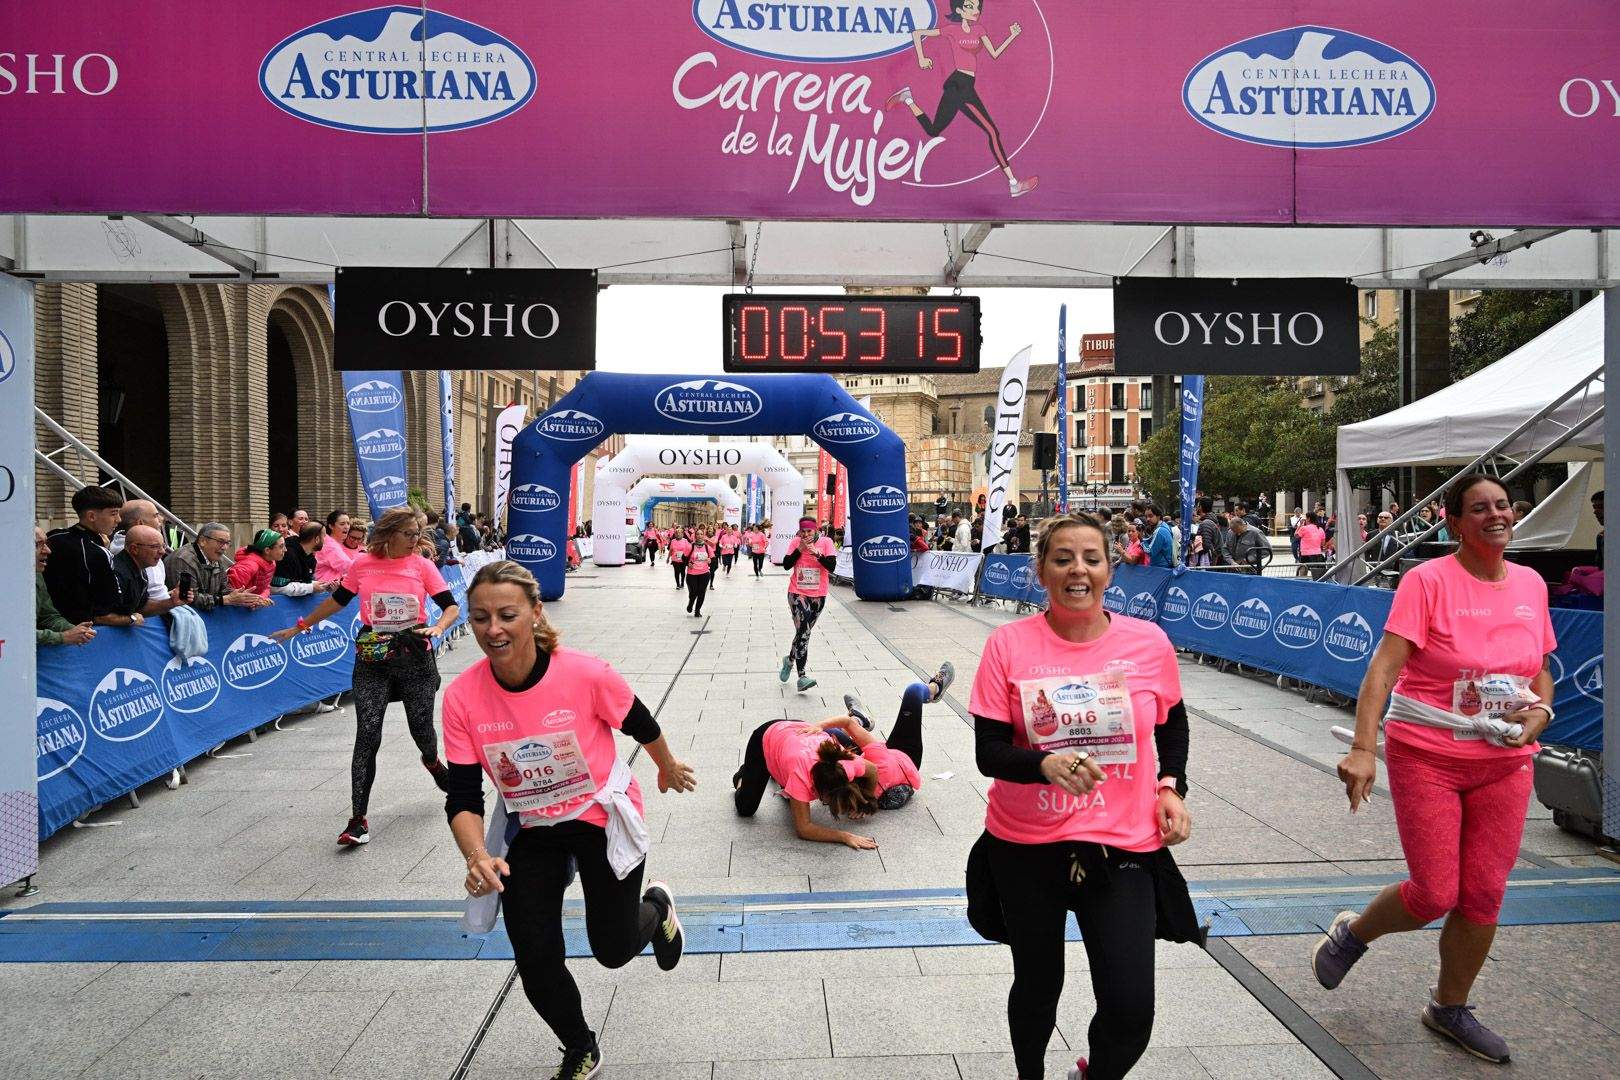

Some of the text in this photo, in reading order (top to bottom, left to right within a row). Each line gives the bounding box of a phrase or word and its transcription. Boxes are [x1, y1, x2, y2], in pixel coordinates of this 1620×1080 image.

[712, 0, 917, 34] ASTURIANA
[324, 50, 507, 64] CENTRAL LECHERA
[280, 52, 517, 101] ASTURIANA
[672, 51, 873, 113] Carrera
[1242, 68, 1409, 81] CENTRAL LECHERA
[1203, 70, 1417, 116] ASTURIANA
[721, 110, 946, 206] de la Mujer
[378, 301, 560, 339] OYSHO
[1154, 311, 1324, 346] OYSHO
[1085, 339, 1115, 351] TIBUR
[662, 393, 754, 413] ASTURIANA
[540, 420, 598, 434] ASTURIANA
[819, 424, 876, 438] ASTURIANA
[659, 448, 742, 466] OYSHO
[512, 494, 557, 506] ASTURIANA
[508, 543, 553, 556] ASTURIANA
[930, 554, 969, 573] OYSHO
[1232, 611, 1268, 631] ASTURIANA
[1275, 618, 1318, 641] ASTURIANA
[296, 635, 346, 660] ASTURIANA
[228, 652, 285, 682] ASTURIANA
[1028, 665, 1071, 675] OYSHO
[167, 674, 218, 703] ASTURIANA
[96, 692, 162, 733] ASTURIANA
[1484, 700, 1513, 710] 016
[40, 713, 72, 729] LECHERA
[1061, 710, 1097, 725] 016
[477, 721, 514, 733] OYSHO
[1069, 728, 1092, 736] 8803
[516, 748, 551, 760] ASTURIANA
[523, 765, 554, 780] 016
[532, 778, 554, 787] 8784
[1037, 790, 1107, 813] SUMA
